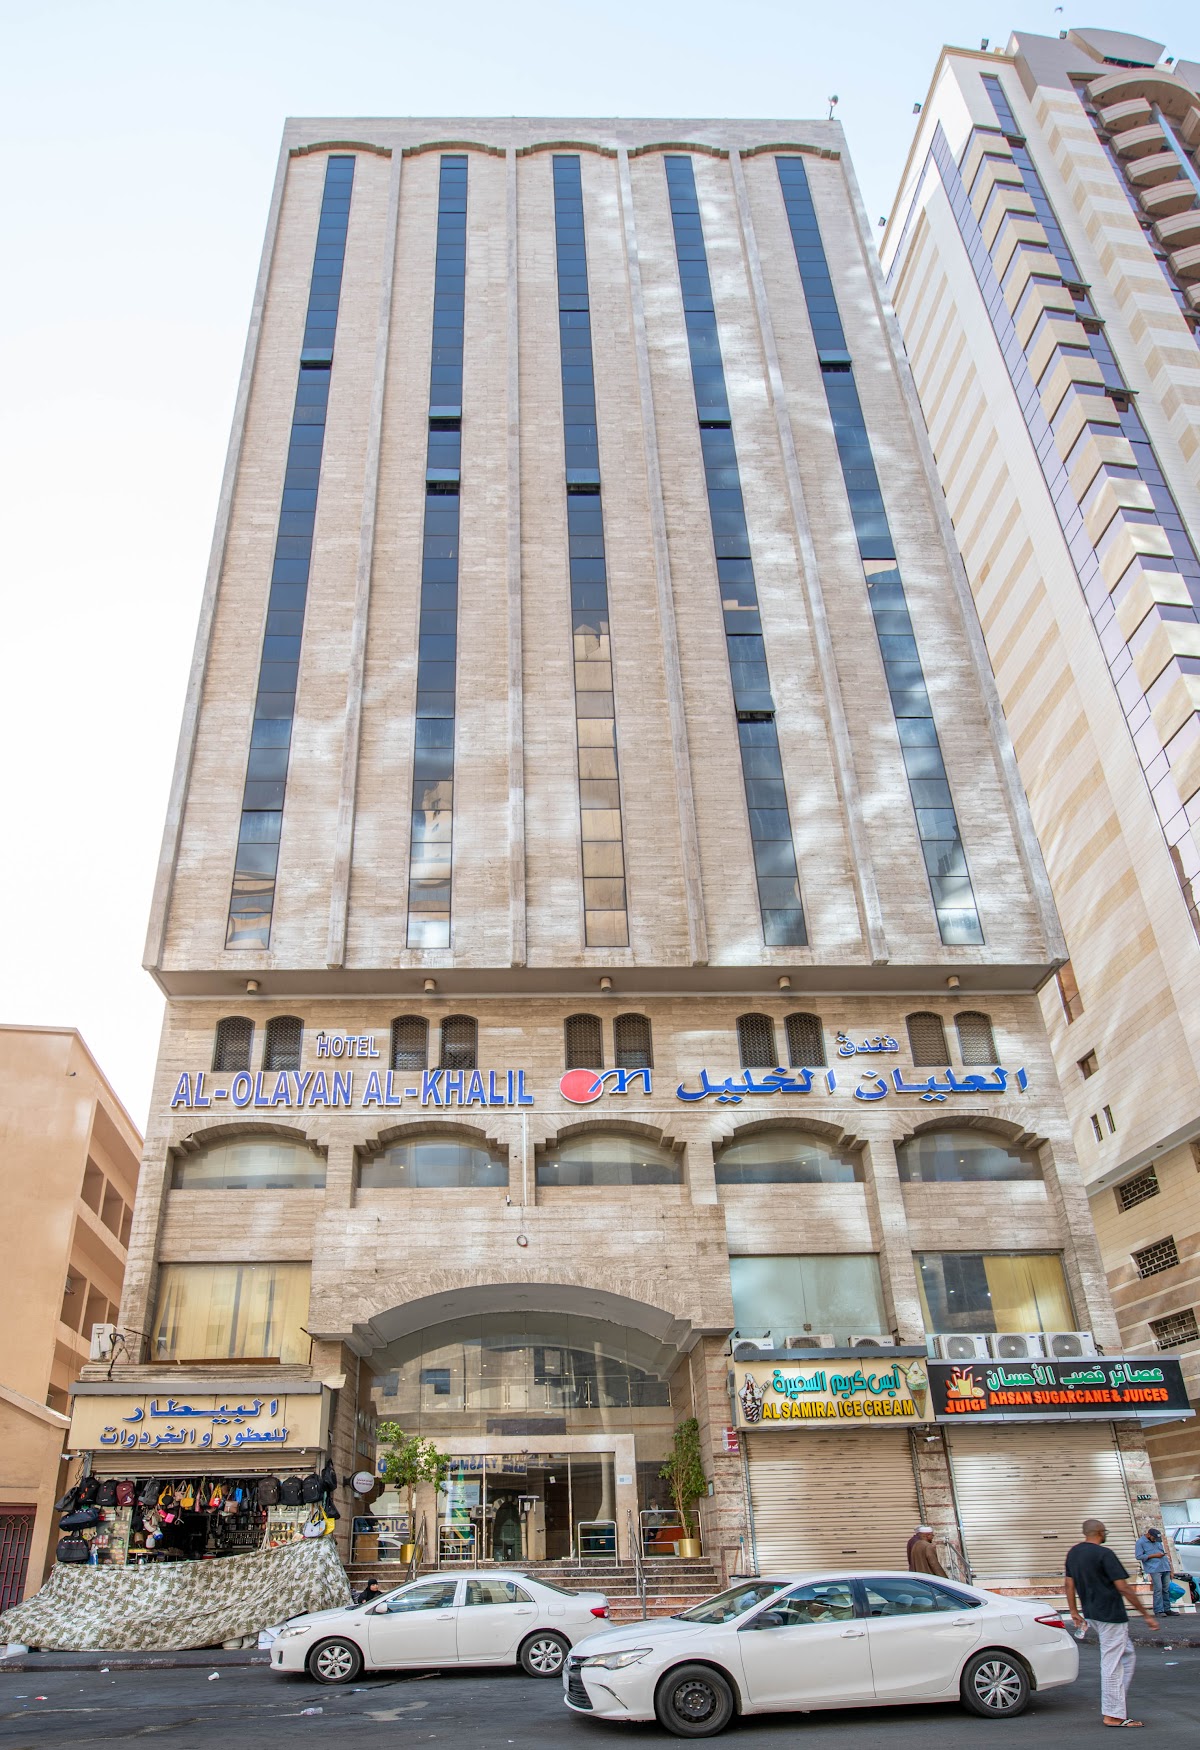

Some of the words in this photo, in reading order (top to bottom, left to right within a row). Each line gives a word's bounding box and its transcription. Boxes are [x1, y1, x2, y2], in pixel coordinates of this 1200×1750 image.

[316, 1034, 380, 1058] HOTEL
[837, 1035, 899, 1057] فندق
[169, 1070, 354, 1108] AL-OLAYAN
[361, 1068, 535, 1107] AL-KHALIL
[675, 1066, 838, 1104] الخليل
[854, 1065, 1029, 1103] العليان
[772, 1369, 828, 1400] السميرة
[830, 1369, 868, 1399] كريم
[1059, 1364, 1107, 1390] قصب
[1109, 1363, 1164, 1387] عصائر
[944, 1399, 987, 1414] JUICE
[989, 1391, 1033, 1406] AHSAN
[1034, 1389, 1110, 1405] SUGARCANE
[1109, 1389, 1121, 1403] &
[1121, 1387, 1169, 1403] JUICES
[122, 1397, 279, 1425] البيطار
[762, 1402, 781, 1419] AL
[781, 1400, 837, 1418] SAMIRA
[838, 1400, 863, 1418] ICE
[863, 1399, 915, 1417] CREAM
[99, 1424, 196, 1448] الخردوات
[199, 1430, 213, 1447] و
[217, 1426, 288, 1447] للعطور
